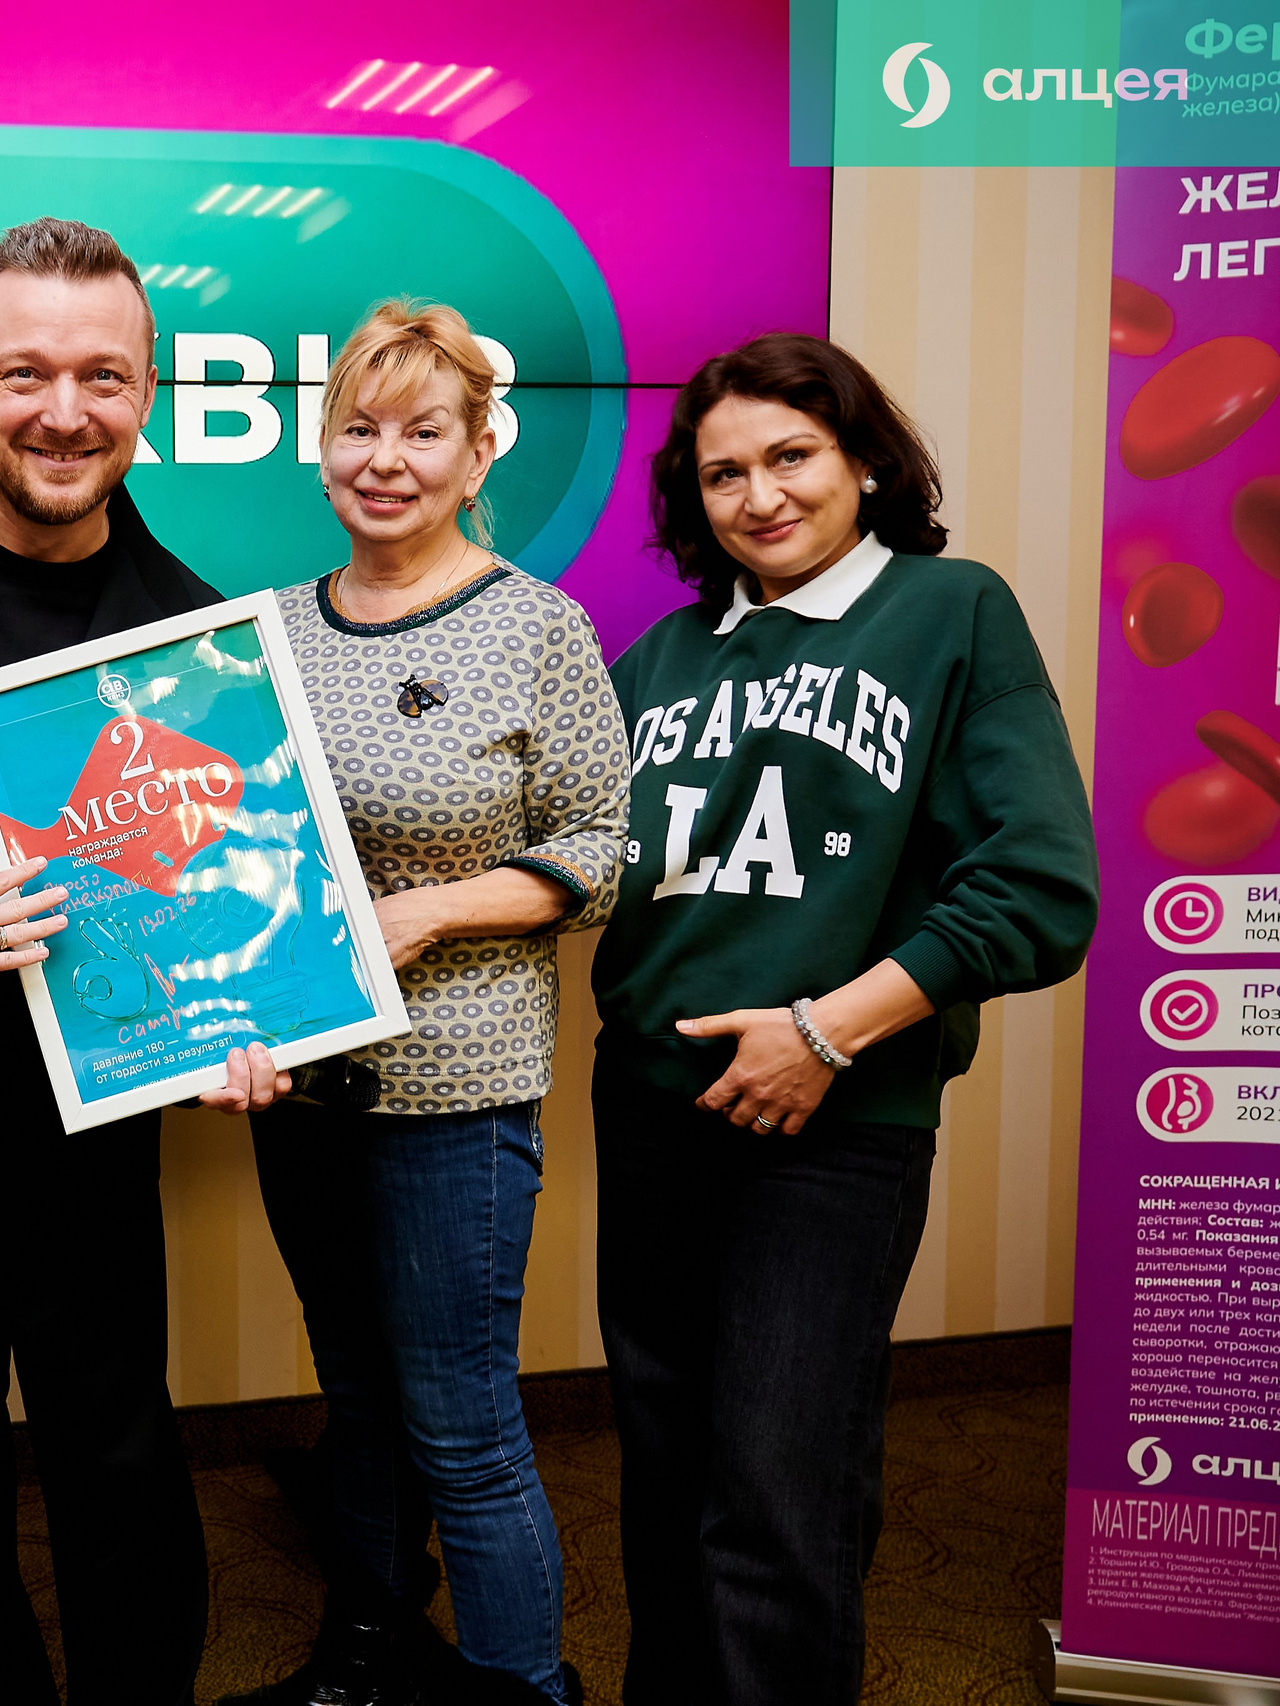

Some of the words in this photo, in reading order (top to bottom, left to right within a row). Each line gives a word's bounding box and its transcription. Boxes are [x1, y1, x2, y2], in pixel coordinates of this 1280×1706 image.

[1185, 18, 1280, 61] Фе
[1182, 92, 1280, 117] железа)
[1179, 170, 1280, 214] ЖЕ
[631, 697, 698, 777] OS
[693, 662, 911, 794] ANGELES
[110, 721, 155, 780] 2
[68, 826, 149, 857] награждается
[653, 766, 805, 900] LA
[824, 831, 851, 857] 98
[72, 847, 124, 869] команда:
[1248, 887, 1280, 904] ВИ
[1246, 908, 1280, 923] Ми
[1245, 928, 1280, 942] под
[1243, 984, 1280, 998] ПР
[118, 1004, 185, 1044] Самар
[92, 1049, 144, 1073] давление
[145, 1040, 165, 1055] 180
[96, 1073, 109, 1085] от
[111, 1057, 161, 1080] гордости
[163, 1054, 176, 1065] за
[177, 1034, 234, 1062] результат!
[1237, 1106, 1280, 1121] 202
[1140, 1175, 1270, 1190] СОКРАЩЕННАЯ
[1138, 1198, 1176, 1210] МНН:
[1179, 1201, 1229, 1211] железа
[1138, 1214, 1202, 1227] действия;
[1208, 1214, 1264, 1228] Состав:
[1137, 1229, 1165, 1241] 0,54
[1172, 1232, 1188, 1241] мг.
[1195, 1229, 1279, 1244] Показания
[1137, 1246, 1223, 1257] вызываемых
[1227, 1245, 1280, 1261] береме
[1135, 1262, 1227, 1272] длительными
[1135, 1277, 1222, 1289] применения
[1231, 1280, 1241, 1289] и
[1134, 1292, 1212, 1303] жидкостью.
[1218, 1292, 1246, 1306] При
[1133, 1307, 1151, 1318] до
[1154, 1308, 1185, 1319] двух
[1189, 1309, 1215, 1318] или
[1219, 1310, 1251, 1321] трех
[1133, 1323, 1181, 1333] недели
[1189, 1324, 1231, 1335] после
[1239, 1327, 1280, 1338] дости
[1132, 1338, 1207, 1349] сыворотки,
[1132, 1353, 1183, 1364] хорошо
[1188, 1354, 1278, 1369] переносится
[1131, 1367, 1216, 1380] воздействие
[1224, 1372, 1241, 1381] на
[1249, 1374, 1280, 1388] жел
[1130, 1383, 1191, 1394] желудке,
[1196, 1384, 1260, 1400] тошнота,
[1130, 1397, 1146, 1407] по
[1149, 1398, 1220, 1411] истечении
[1224, 1402, 1266, 1415] срока
[1129, 1412, 1224, 1427] применению:
[1228, 1416, 1280, 1432] 21.06.2
[1092, 1498, 1209, 1545] МАТЕРИАЛ
[1217, 1507, 1280, 1561] ПРЕД
[1100, 1547, 1158, 1558] Инструкция
[1160, 1551, 1174, 1560] по
[1176, 1553, 1253, 1569] медицинскому
[1097, 1568, 1138, 1577] терапии
[1140, 1572, 1240, 1588] железодефицитной
[1087, 1589, 1175, 1602] репродуктивного
[1097, 1598, 1163, 1611] Клинические
[1165, 1606, 1241, 1619] рекомендации
